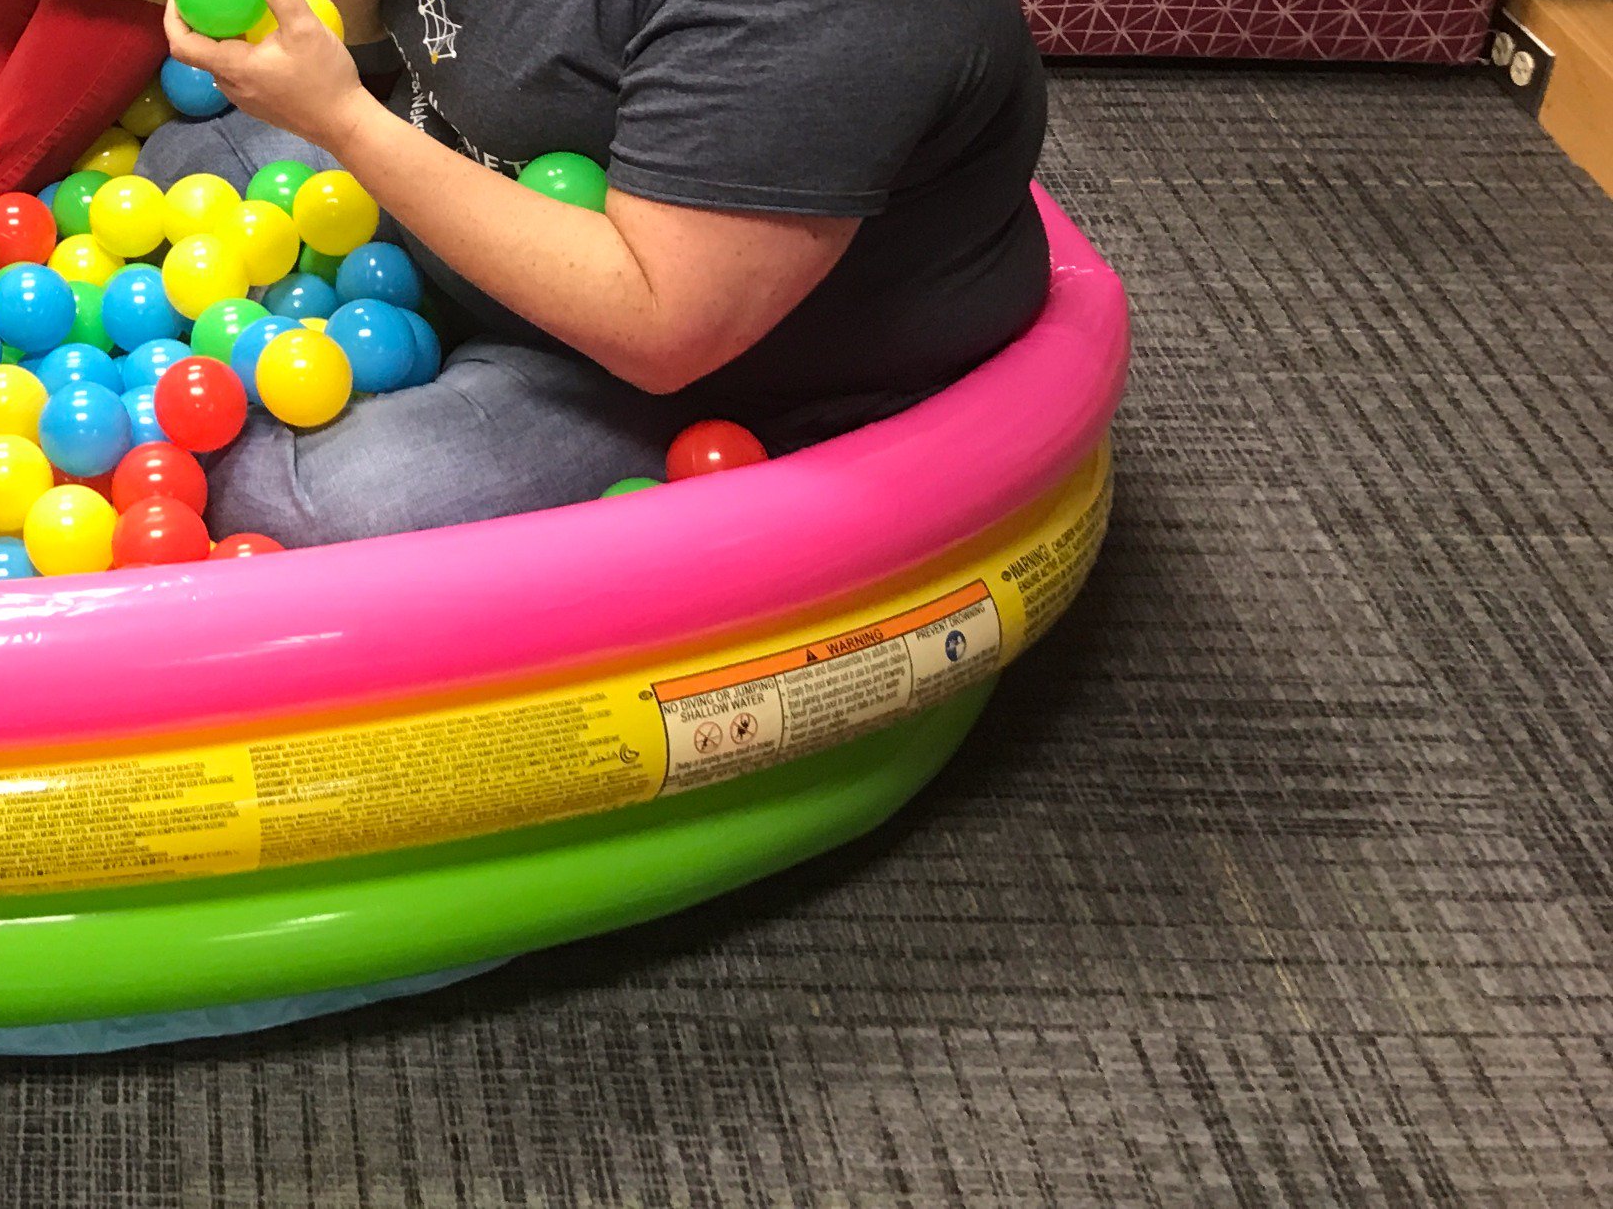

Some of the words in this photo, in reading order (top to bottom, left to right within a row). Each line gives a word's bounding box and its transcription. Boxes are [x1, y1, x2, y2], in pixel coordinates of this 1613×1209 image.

[825, 628, 884, 655] WARNING
[663, 703, 678, 715] NO
[680, 695, 713, 711] DIVING
[716, 691, 730, 702] OR
[733, 678, 776, 699] JUMPING
[680, 702, 730, 723] SHALLOW
[732, 693, 766, 710] WATER
